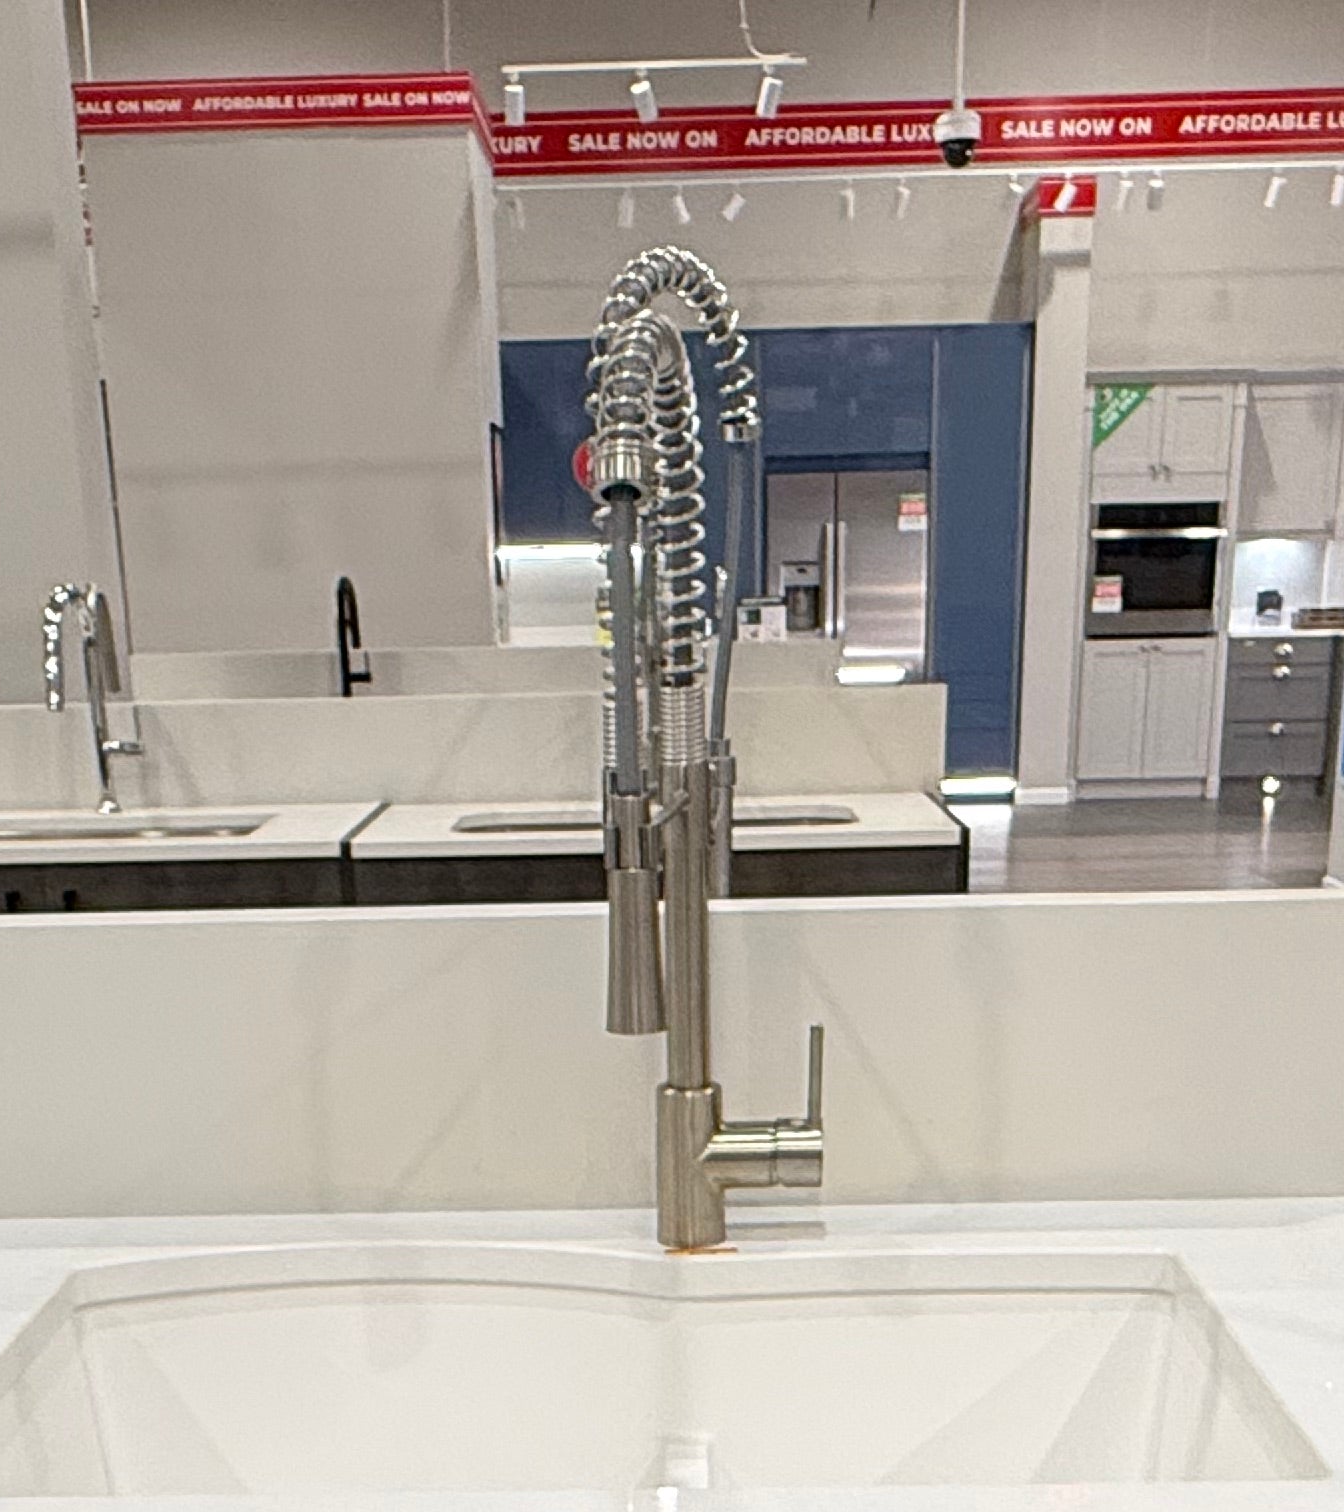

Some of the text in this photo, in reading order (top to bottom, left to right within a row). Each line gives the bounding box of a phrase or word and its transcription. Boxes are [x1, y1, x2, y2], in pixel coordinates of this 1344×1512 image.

[143, 98, 182, 113] NOW
[192, 94, 295, 112] AFFORDABLE
[297, 93, 358, 110] LUXURY
[362, 91, 402, 108] SALE
[404, 91, 429, 106] ON
[431, 90, 471, 105] NOW
[568, 132, 621, 152] SALE
[626, 130, 679, 150] NOW
[685, 129, 718, 148] ON
[744, 124, 885, 146] AFFORDABLE
[1001, 119, 1055, 140] SALE
[1060, 117, 1114, 138] NOW
[1119, 116, 1153, 136] ON
[1179, 111, 1322, 134] AFFORDABLE
